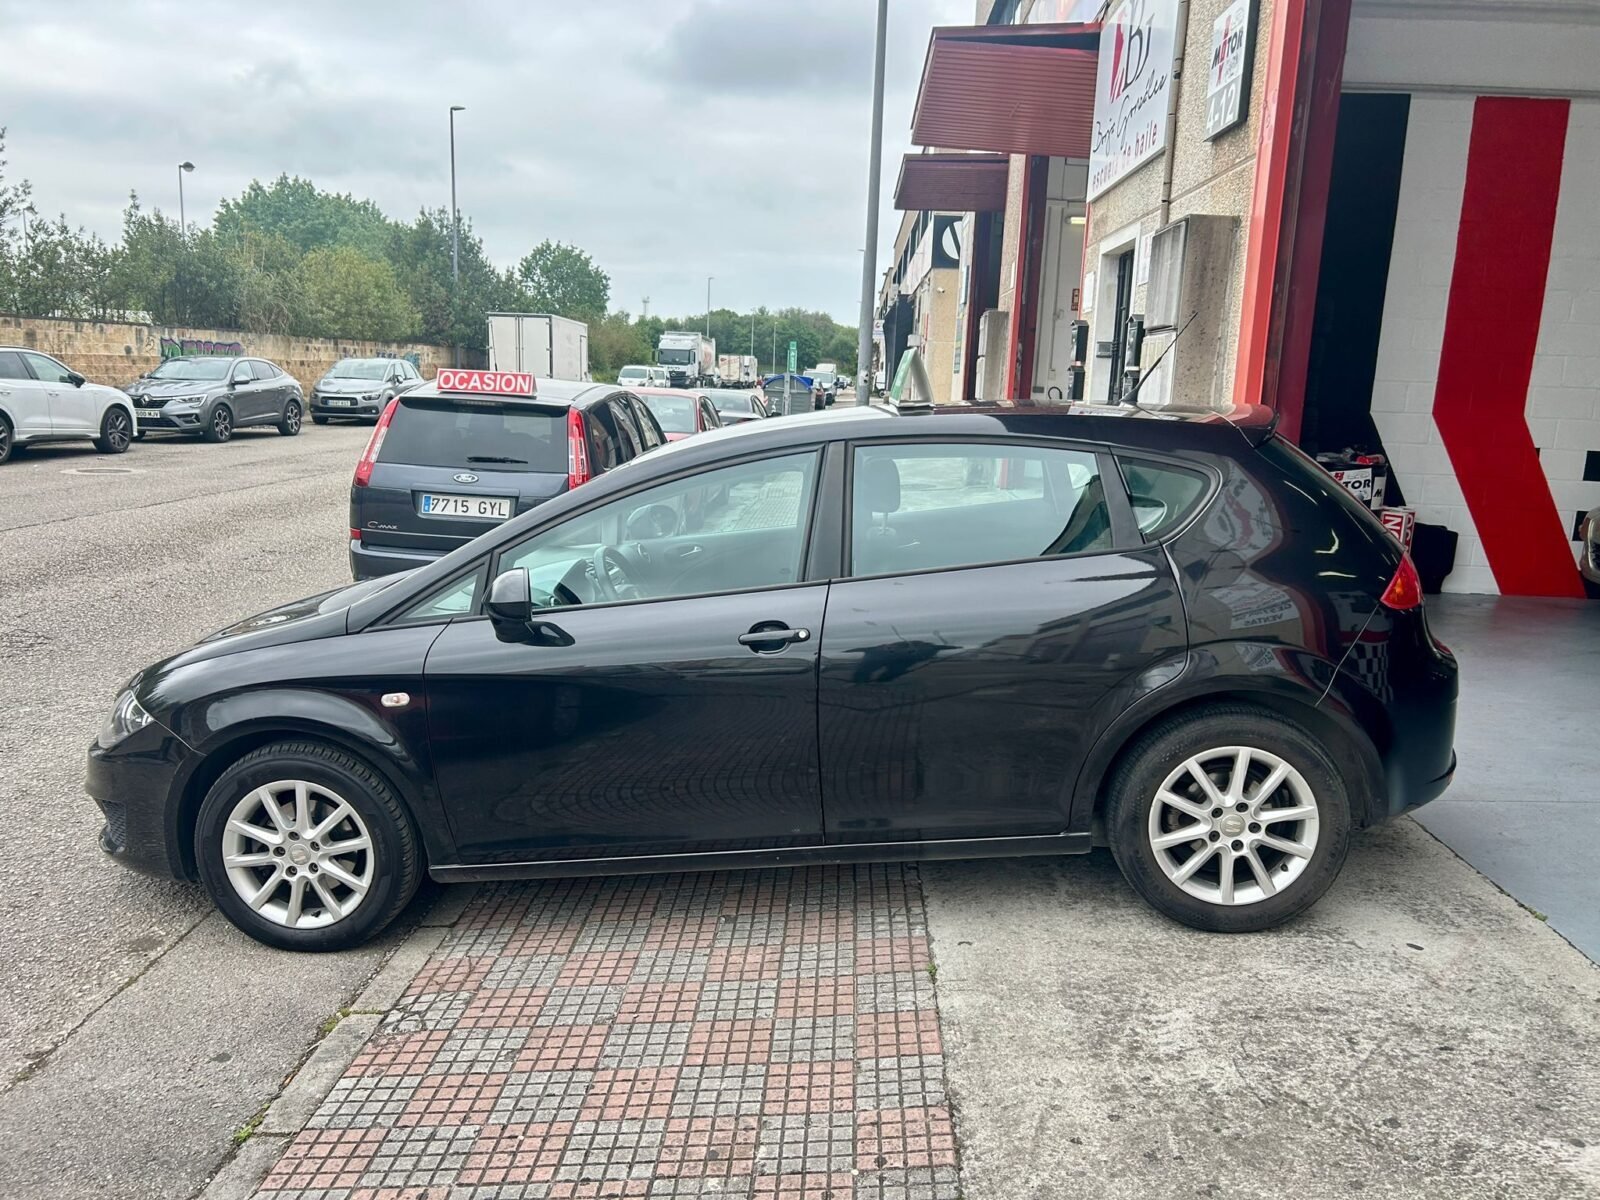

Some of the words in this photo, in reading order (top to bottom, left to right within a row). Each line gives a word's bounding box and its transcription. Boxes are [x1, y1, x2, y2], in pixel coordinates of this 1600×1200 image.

[1206, 83, 1236, 134] 4-12
[1134, 120, 1157, 159] baile
[439, 371, 530, 393] OCASION
[431, 498, 469, 513] 7715
[478, 501, 506, 516] GYL
